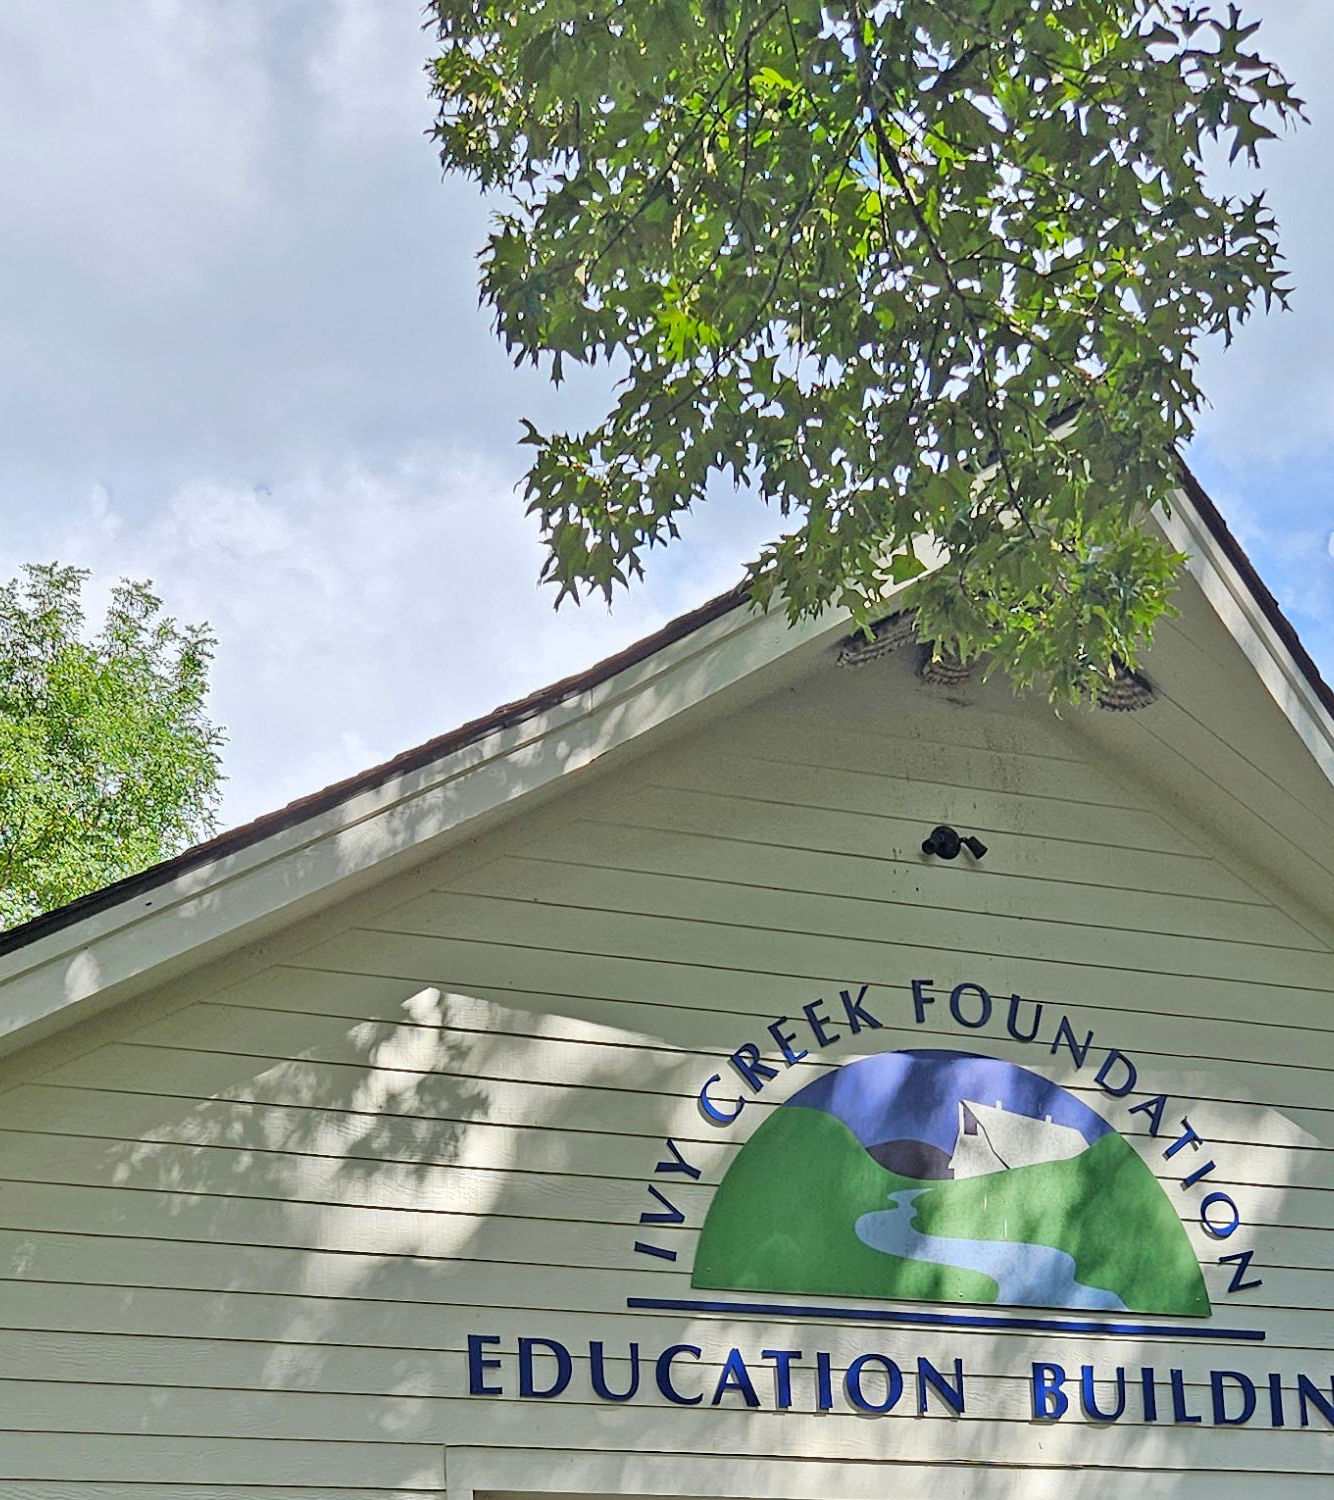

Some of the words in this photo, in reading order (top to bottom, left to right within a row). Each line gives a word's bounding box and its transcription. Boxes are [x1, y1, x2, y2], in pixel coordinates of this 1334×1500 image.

[634, 1139, 702, 1261] IVY
[698, 984, 882, 1127] CREEK
[912, 978, 1262, 1293] FOUNDATION
[467, 1334, 965, 1416] EDUCATION
